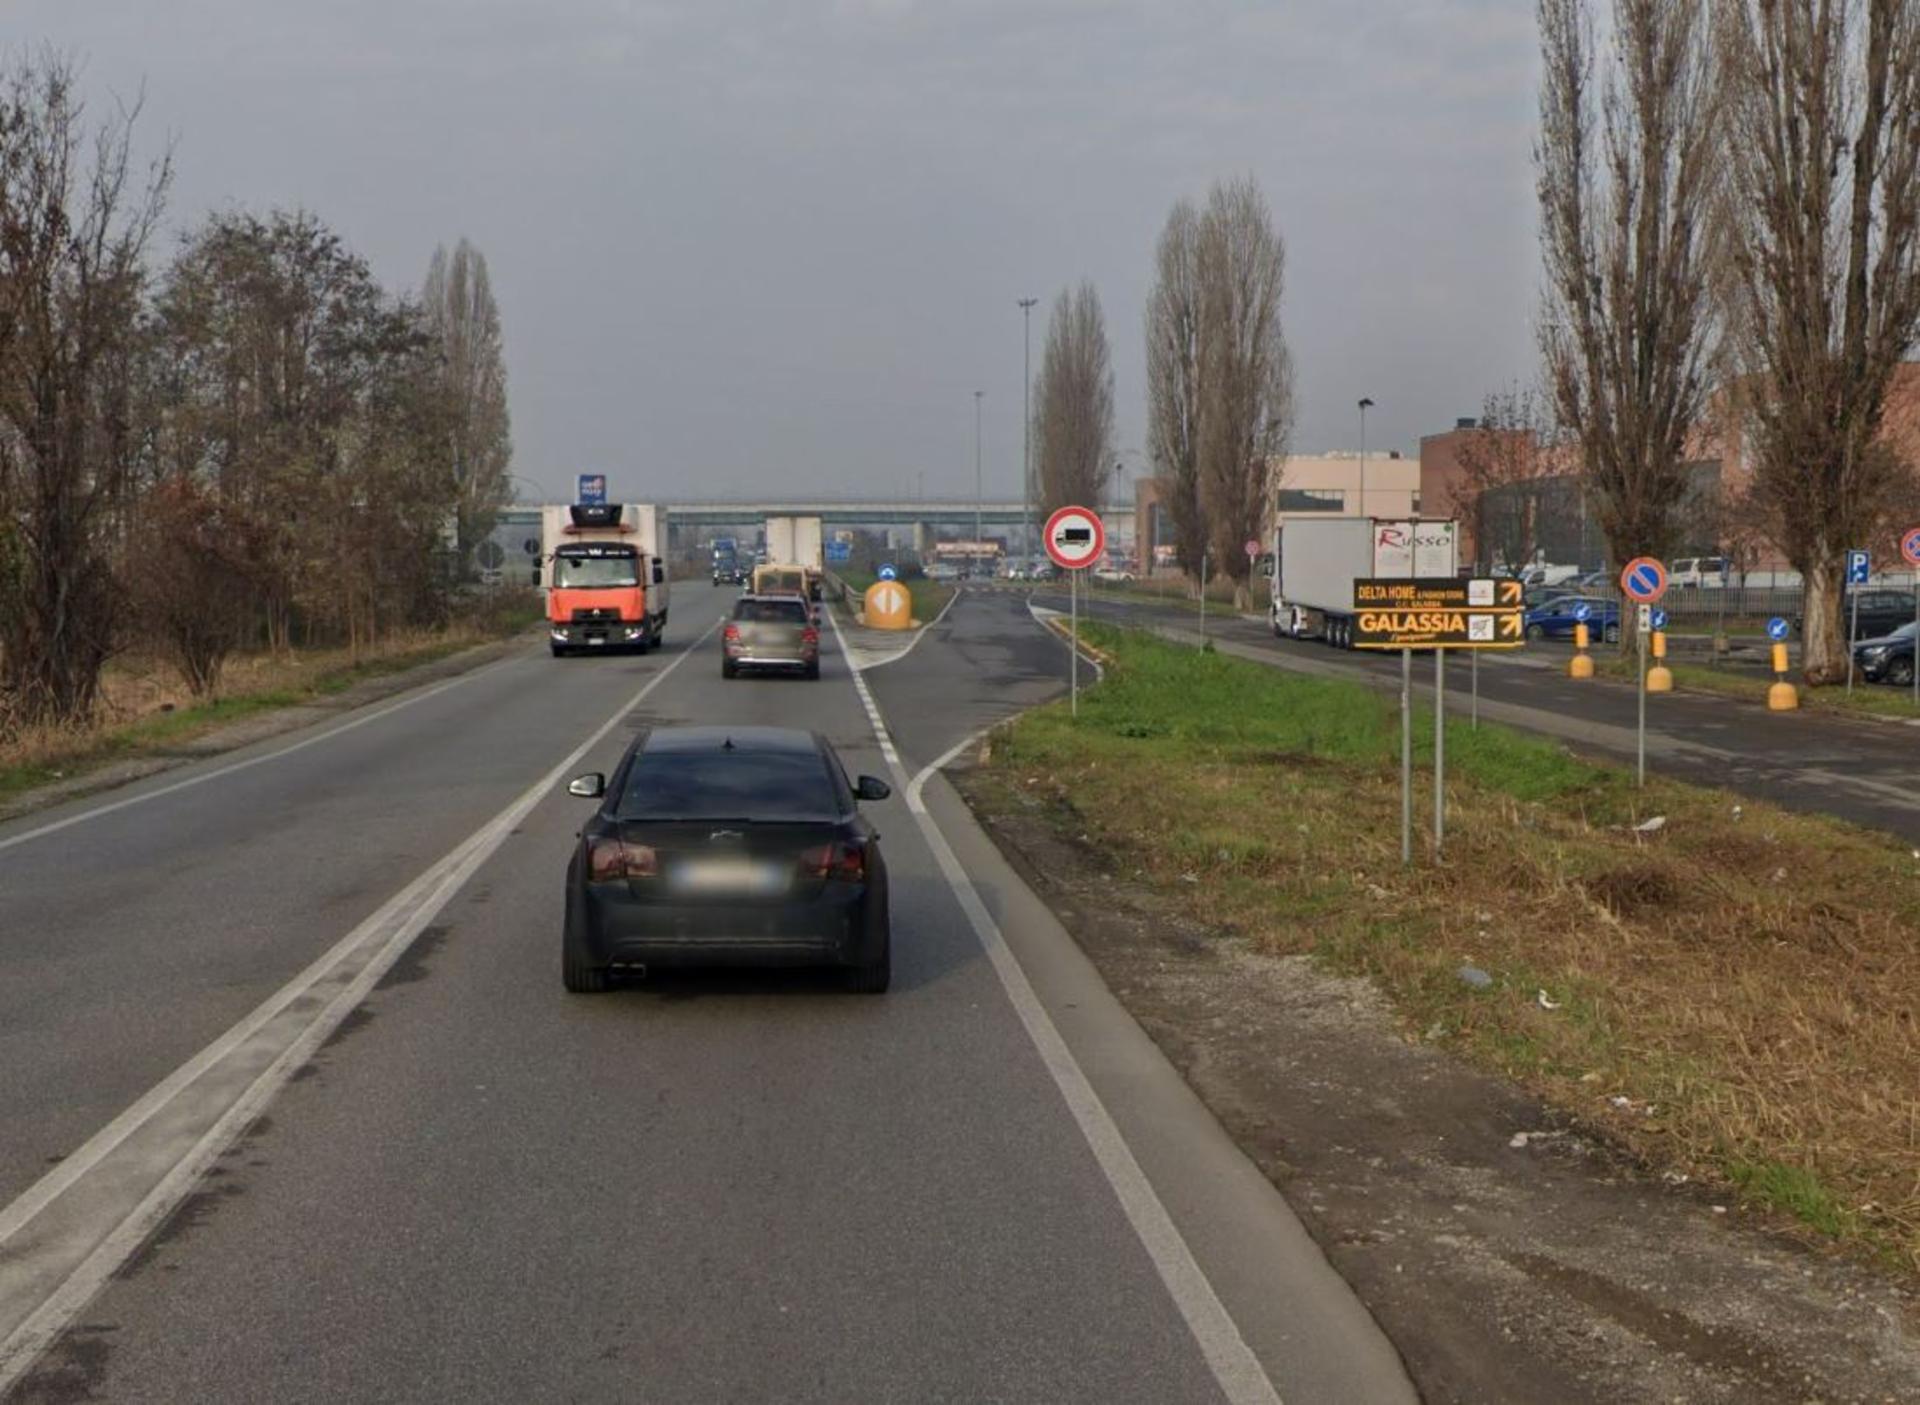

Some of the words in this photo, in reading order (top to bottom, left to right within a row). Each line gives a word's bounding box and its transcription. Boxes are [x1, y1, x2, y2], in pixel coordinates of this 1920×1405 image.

[1854, 554, 1866, 570] P
[1359, 586, 1387, 600] DELTA
[1388, 586, 1416, 600] HOME
[1359, 613, 1465, 632] GALASSIA
